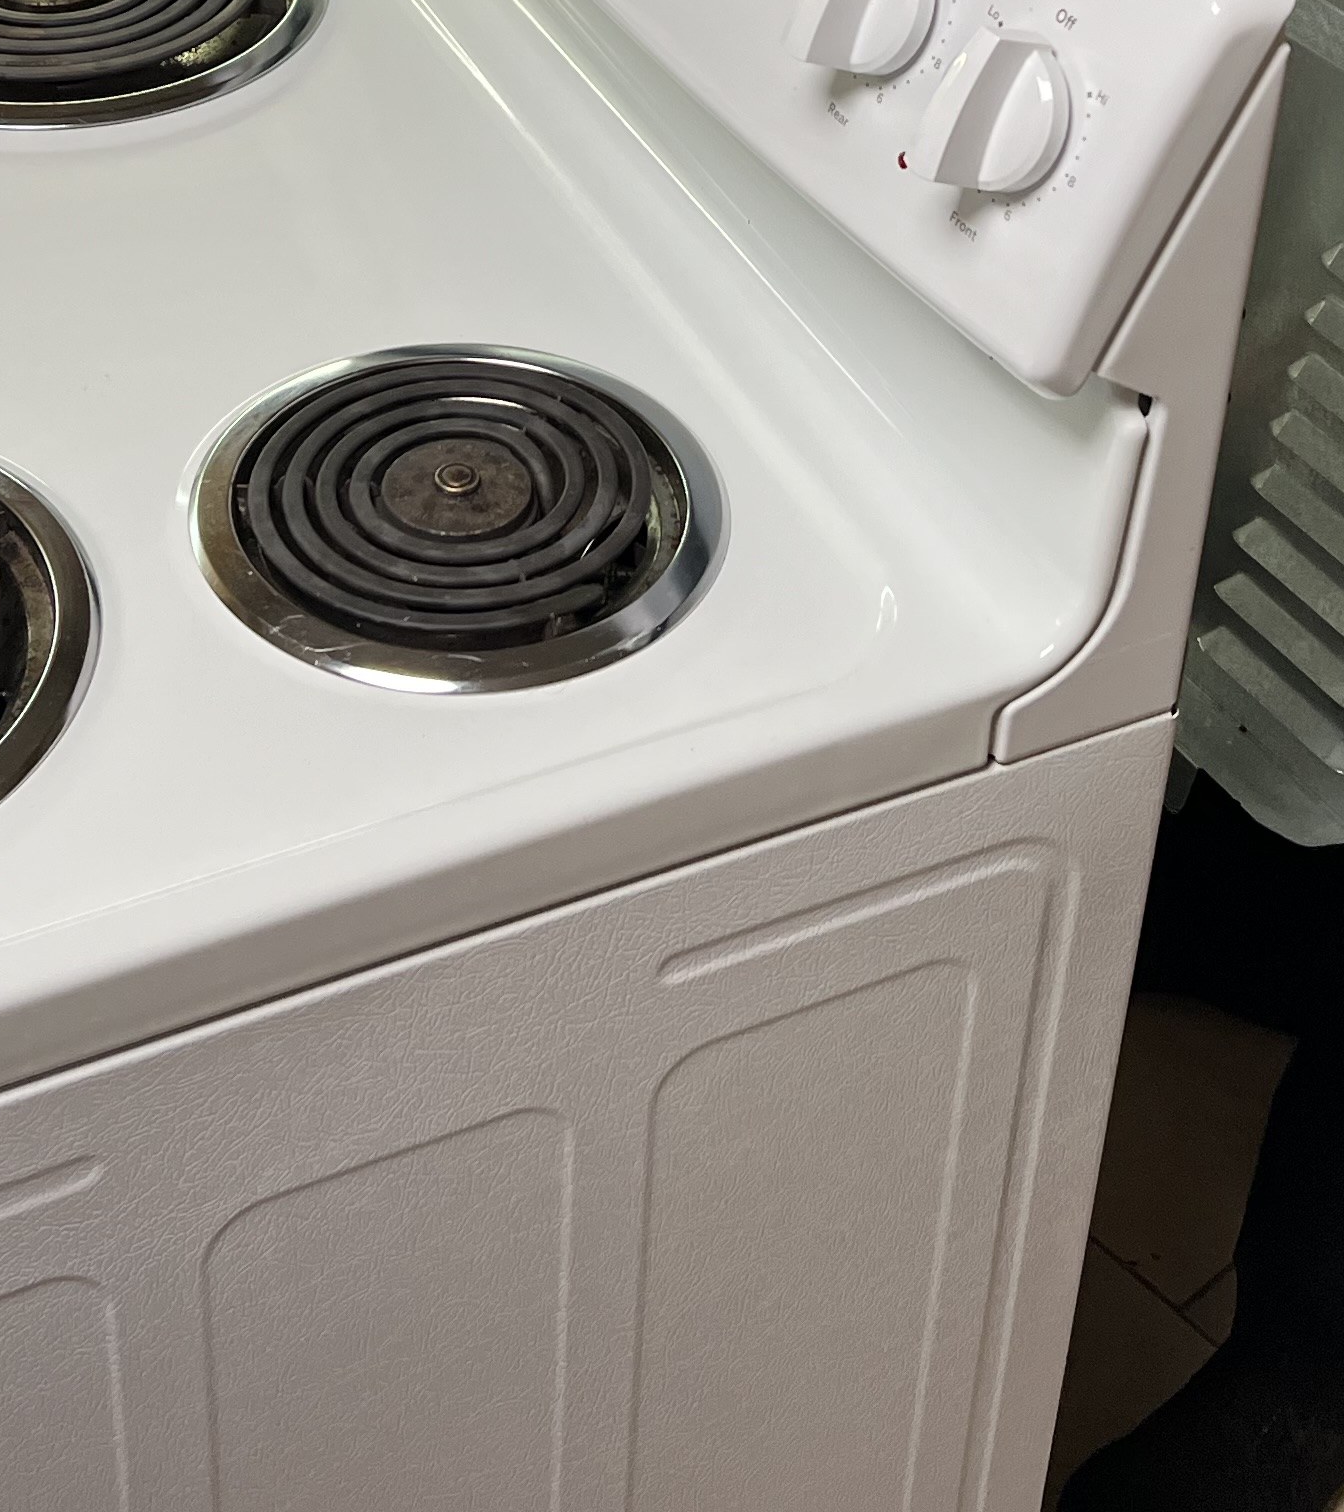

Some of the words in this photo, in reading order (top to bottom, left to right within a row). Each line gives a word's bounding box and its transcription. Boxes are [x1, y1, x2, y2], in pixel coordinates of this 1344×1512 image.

[987, 4, 1000, 20] Lo
[1056, 9, 1077, 30] Off
[933, 58, 942, 69] 8
[876, 92, 884, 104] 6
[1096, 90, 1110, 105] Hi
[828, 102, 849, 126] Rear
[1003, 209, 1013, 221] 6
[949, 210, 977, 242] Front
